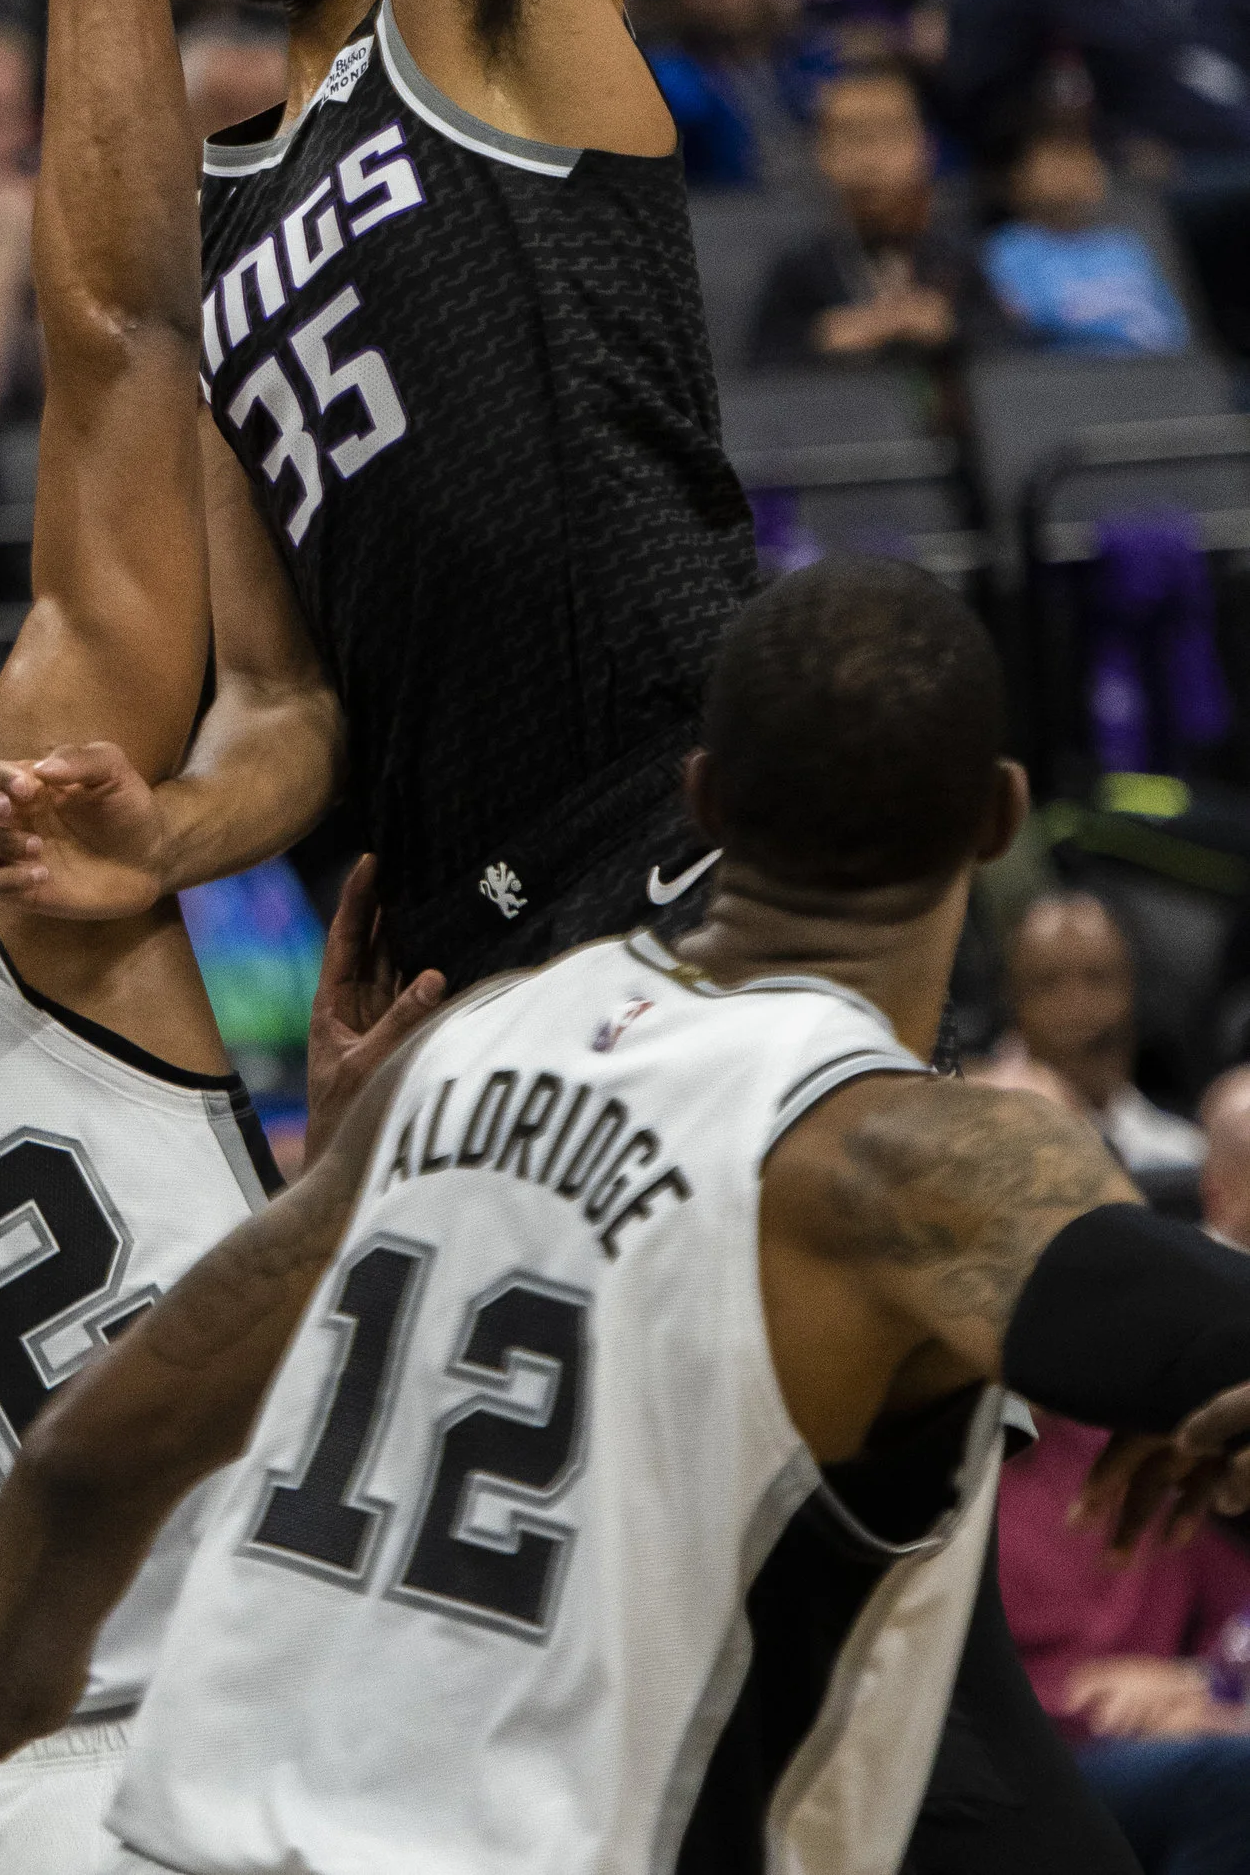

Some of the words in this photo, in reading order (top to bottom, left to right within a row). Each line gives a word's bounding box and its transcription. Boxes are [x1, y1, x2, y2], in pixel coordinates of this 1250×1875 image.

[199, 119, 426, 408] INGS
[226, 284, 410, 547] 35
[379, 1070, 692, 1263] ALDRIDGE
[233, 1229, 596, 1649] 12
